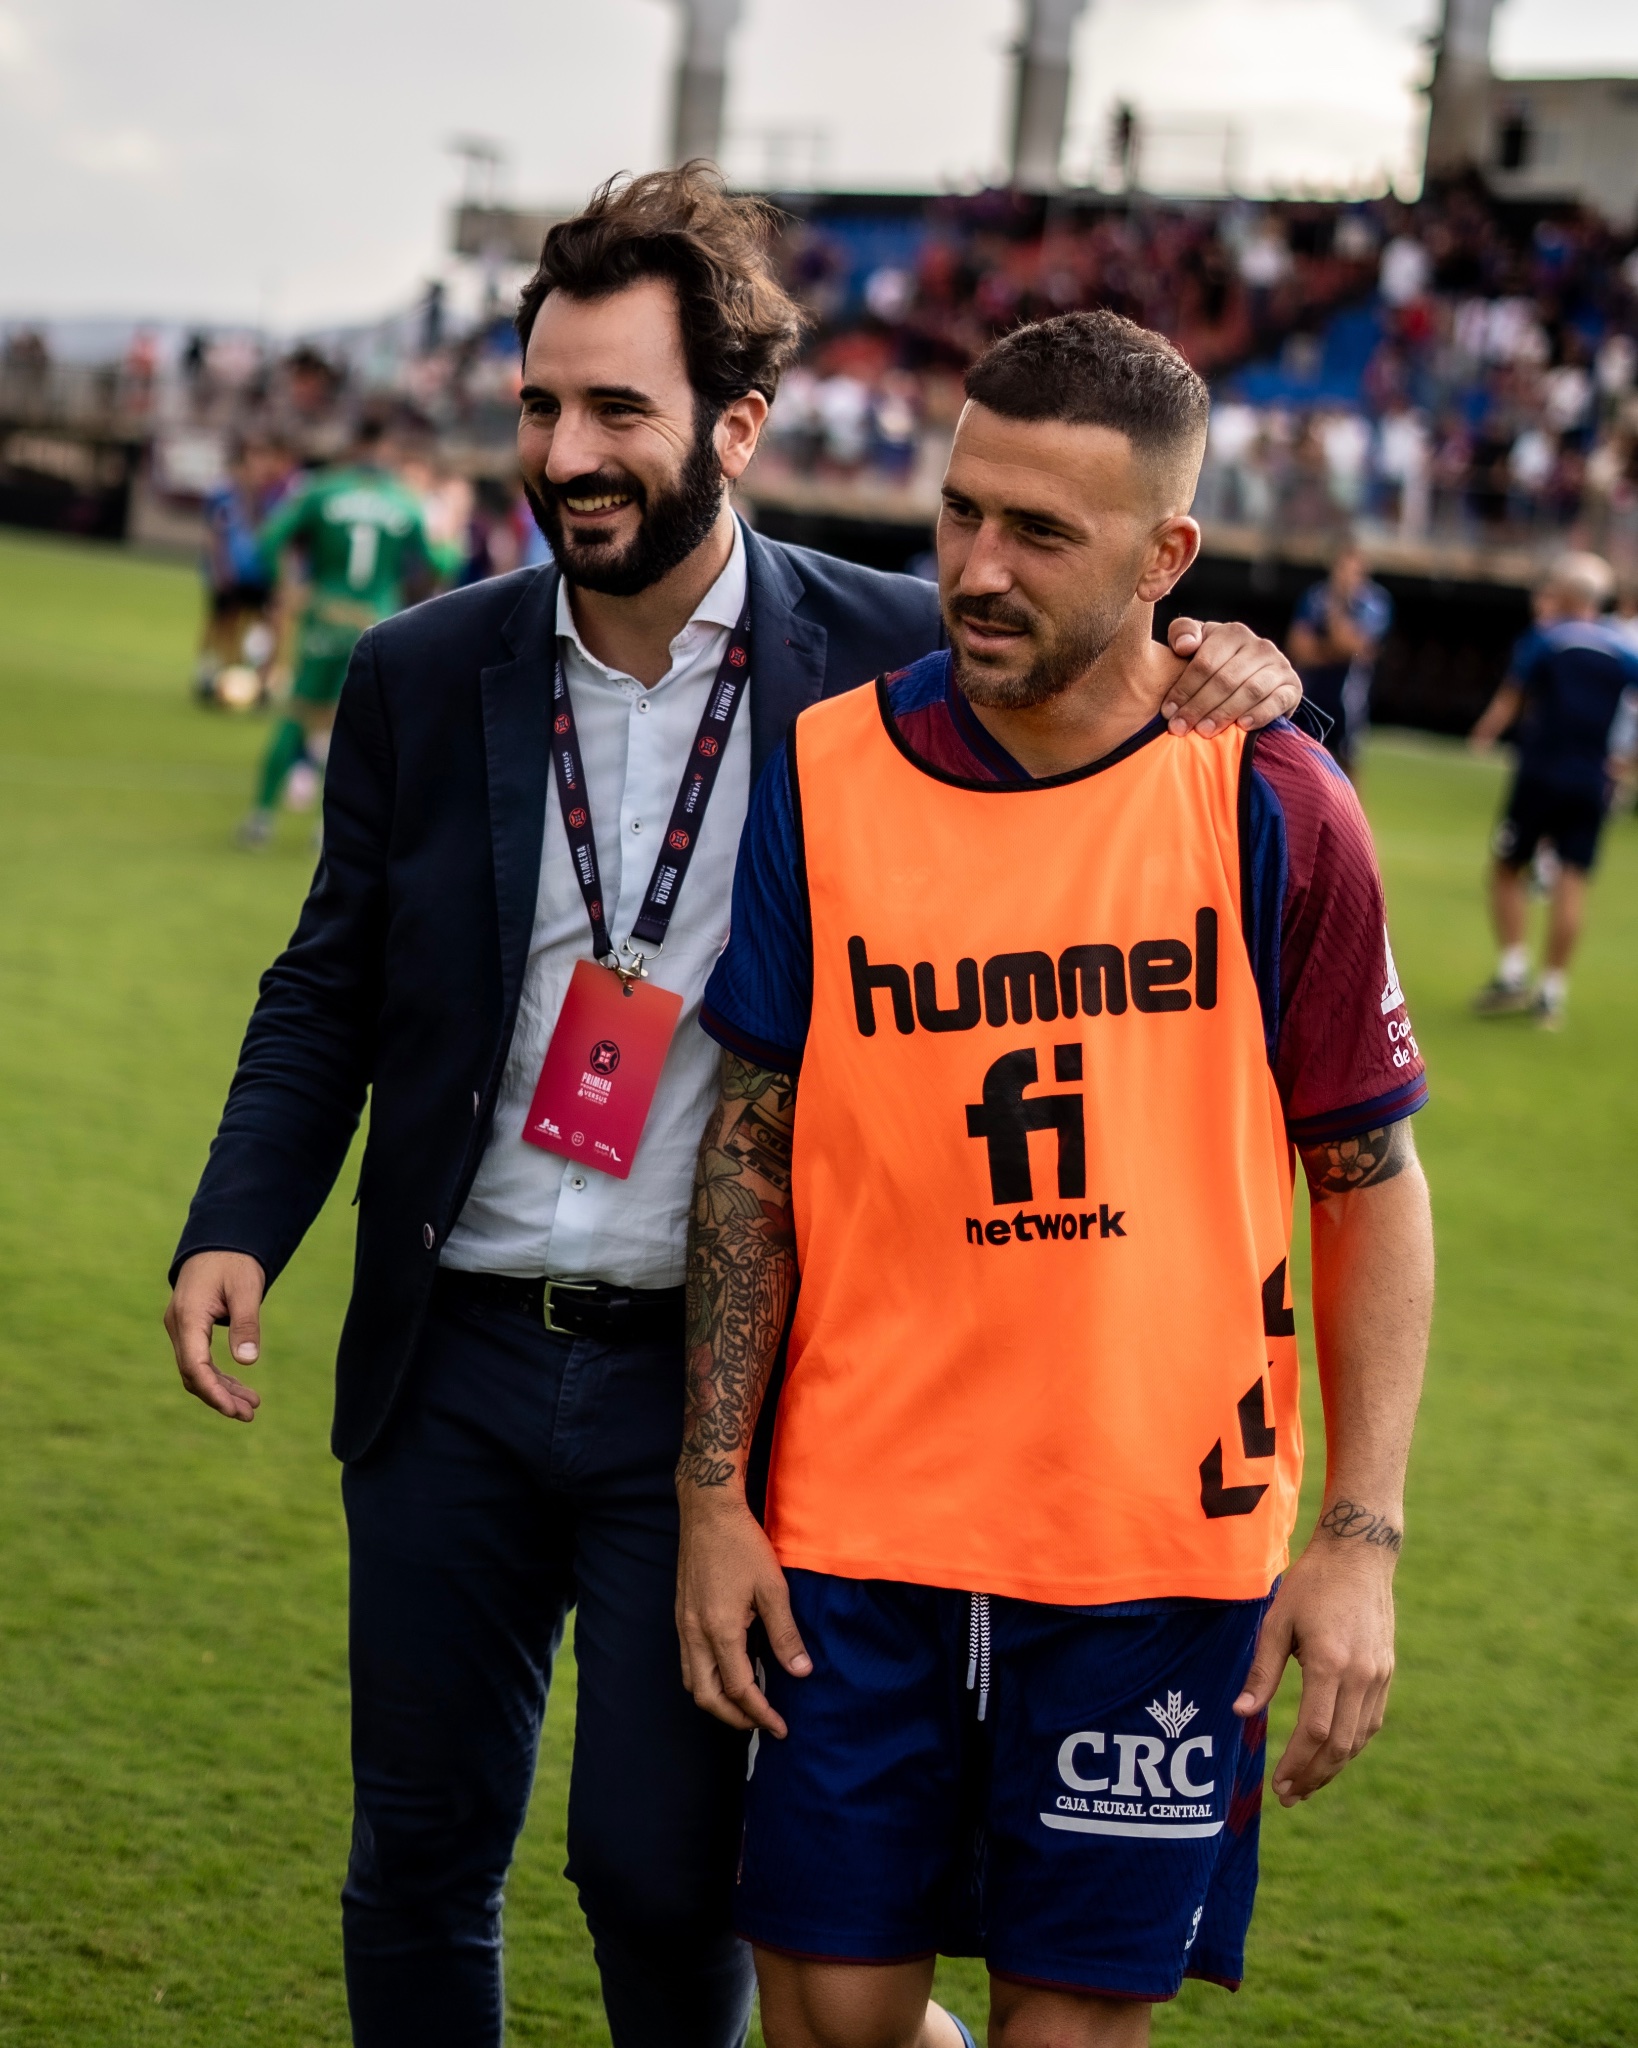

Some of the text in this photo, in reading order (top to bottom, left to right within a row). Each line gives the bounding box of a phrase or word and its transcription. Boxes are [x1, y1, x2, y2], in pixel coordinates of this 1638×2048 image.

[713, 682, 736, 722] PRIMERA
[562, 751, 573, 785] VERSUS
[686, 781, 702, 814] VERSUS
[577, 844, 592, 885] PRIMERA
[655, 866, 678, 905] PRIMERA
[847, 907, 1218, 1038] hummel
[1392, 1044, 1411, 1068] de
[581, 1071, 613, 1093] PRIMERA
[584, 1089, 608, 1104] VERSUS
[965, 1042, 1086, 1206] fi
[594, 1140, 610, 1152] ELDA
[965, 1204, 1127, 1246] network
[1057, 1731, 1215, 1798] CRC
[1056, 1795, 1213, 1818] CAJA RURAL CENTRAL
